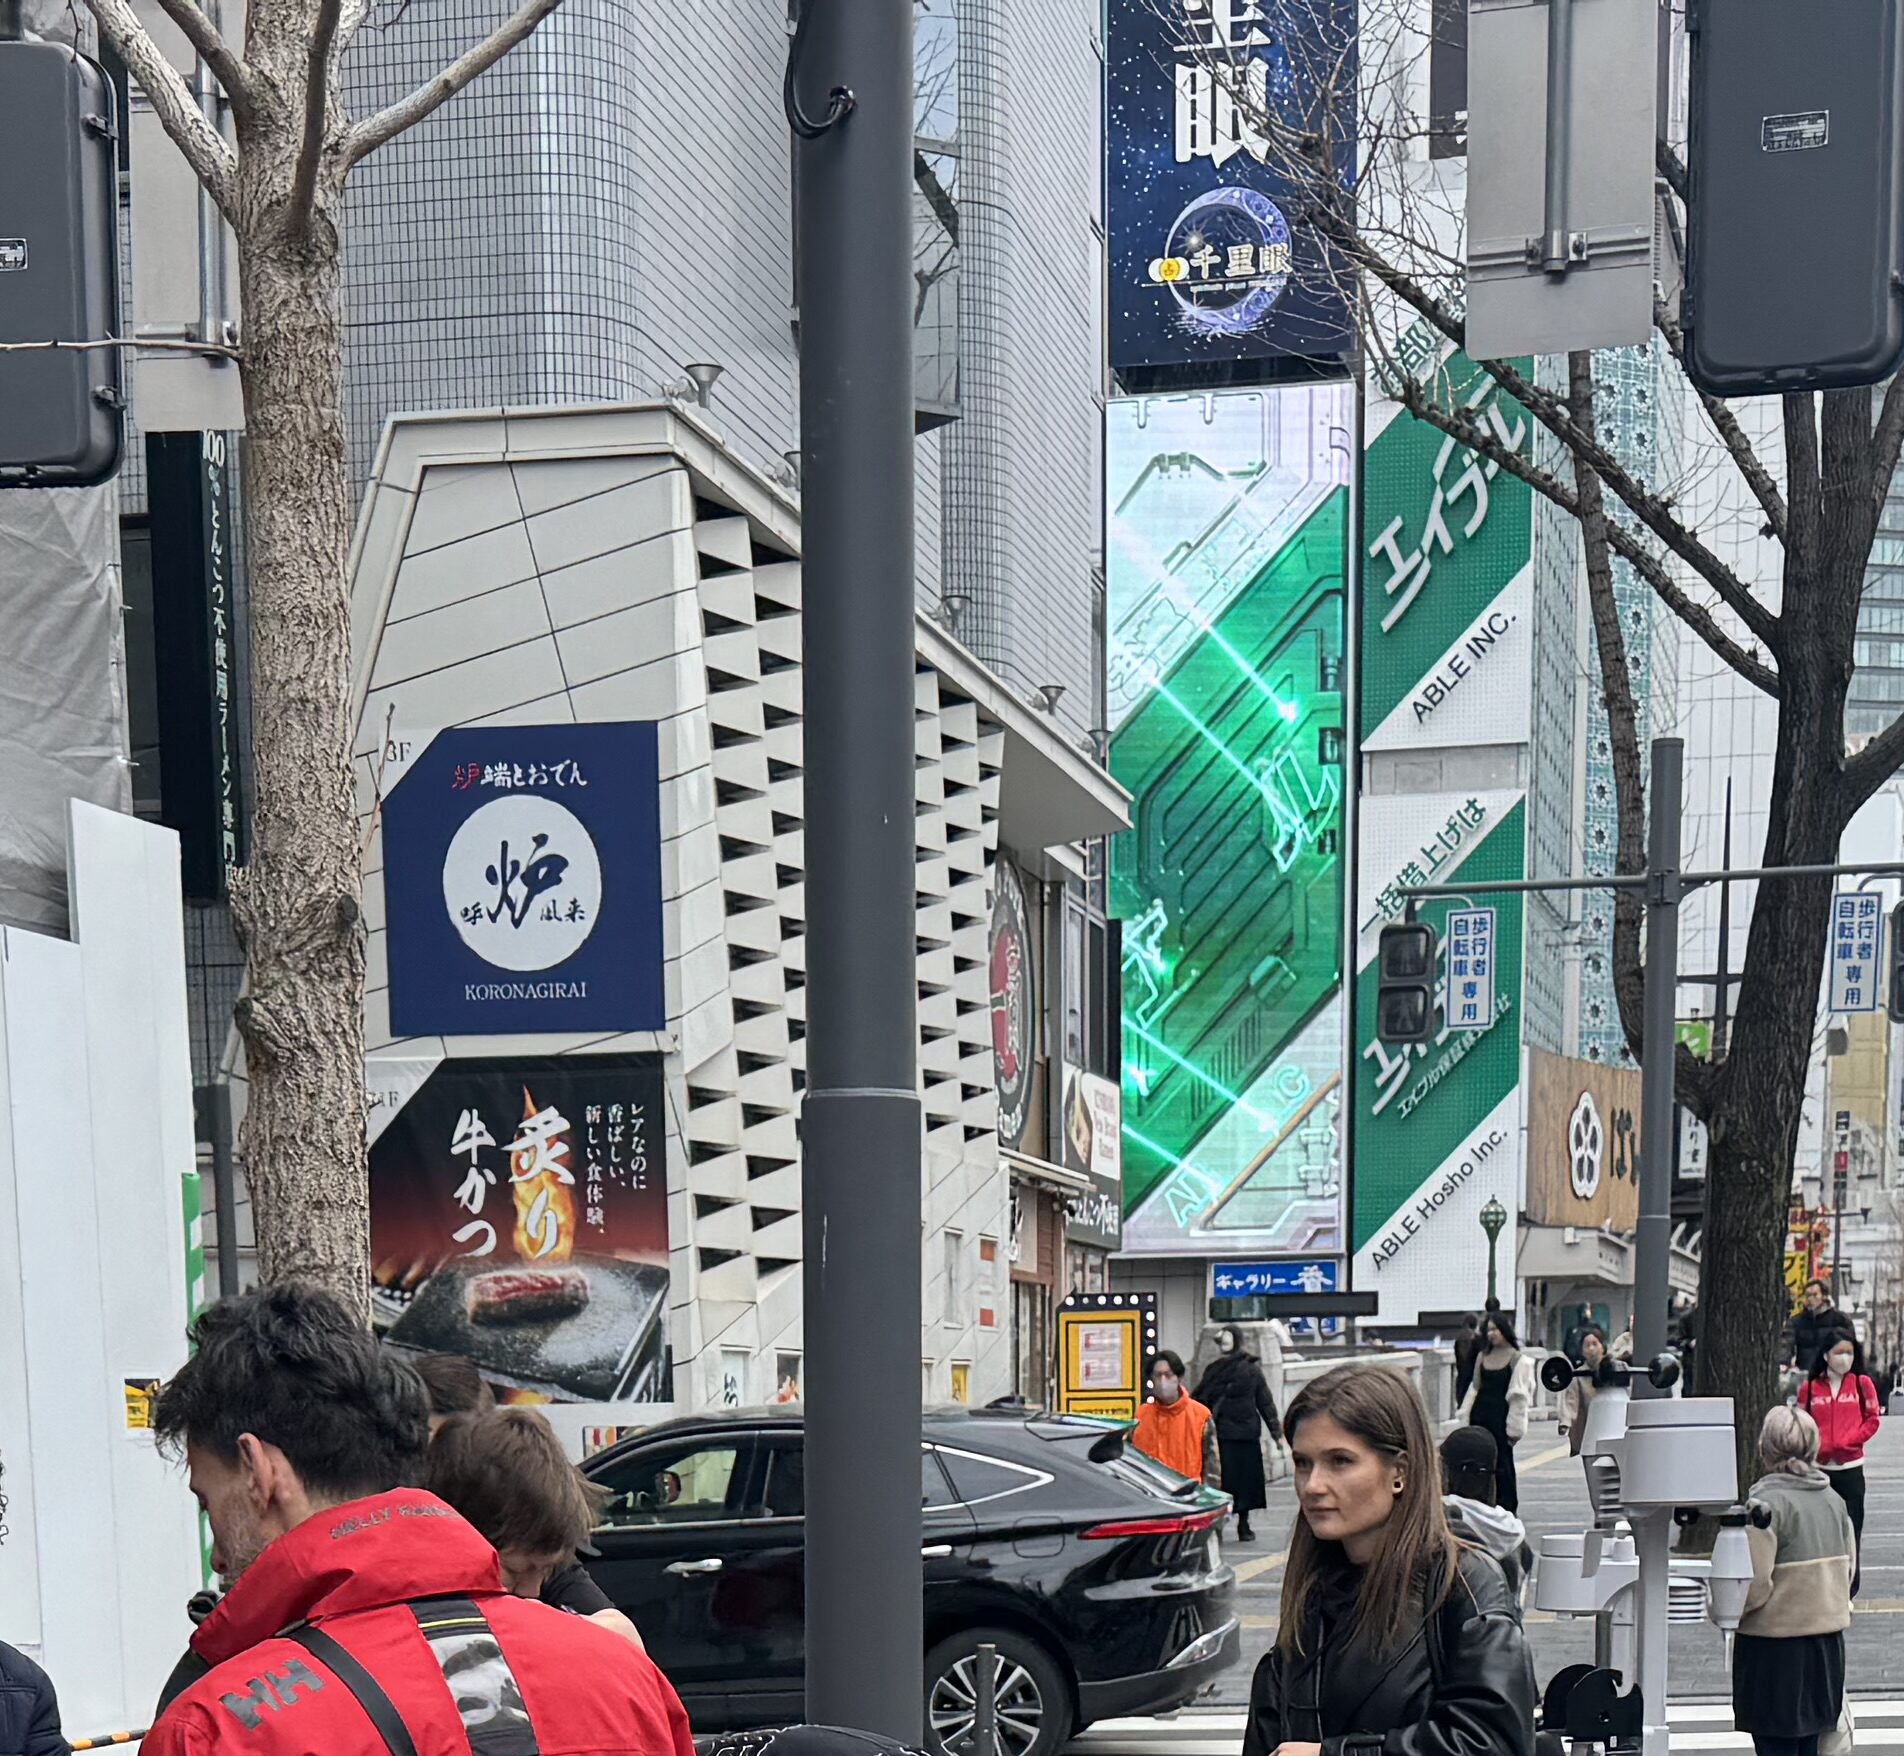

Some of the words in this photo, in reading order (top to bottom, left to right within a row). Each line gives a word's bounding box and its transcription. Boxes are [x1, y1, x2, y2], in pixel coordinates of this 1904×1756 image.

[1190, 244, 1293, 279] 千里眼
[1411, 658, 1471, 724] ABLE
[1464, 611, 1517, 666] INC.
[452, 760, 588, 790] 炉端とおでん
[1453, 918, 1469, 976] 自転車
[1471, 918, 1489, 976] 歩行者
[1837, 900, 1855, 959] 自転車
[1856, 899, 1875, 959] 歩行者
[465, 982, 587, 1001] KORONAGIRAI
[1461, 981, 1477, 1020] 専用
[1844, 965, 1861, 1005] 専用
[630, 1103, 647, 1191] レアなのに
[451, 1108, 497, 1258] 牛かつ
[500, 1105, 576, 1259] 炙り
[1371, 1208, 1425, 1271] ABLE
[1416, 1157, 1475, 1220] Hosho
[1470, 1129, 1509, 1174] Inc.
